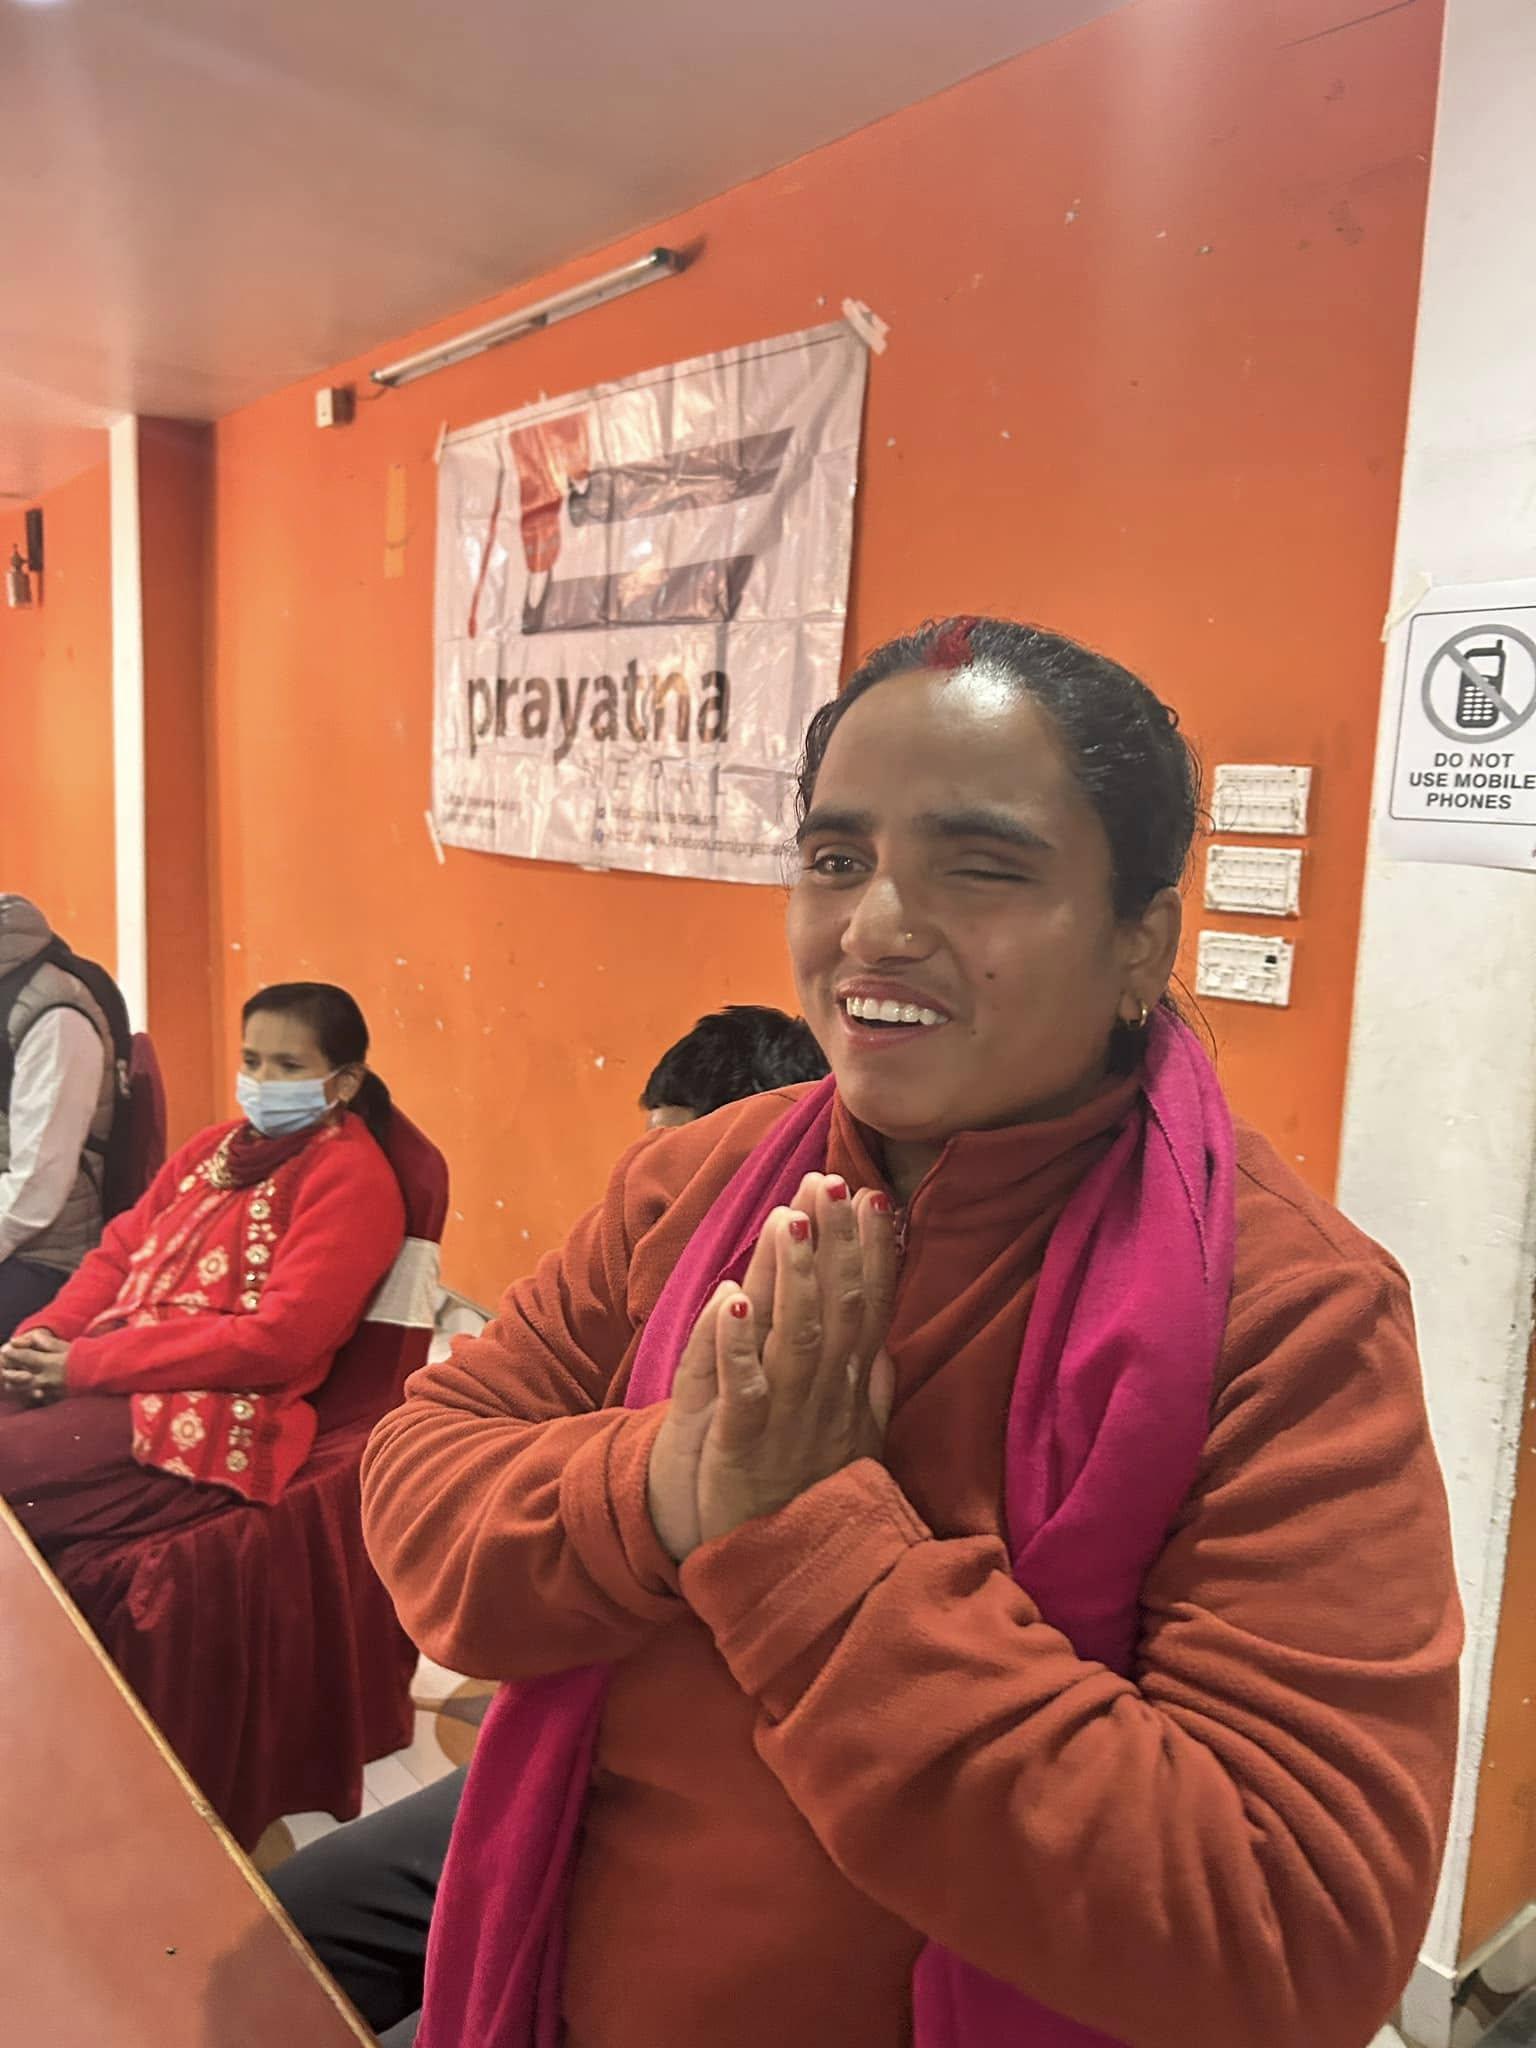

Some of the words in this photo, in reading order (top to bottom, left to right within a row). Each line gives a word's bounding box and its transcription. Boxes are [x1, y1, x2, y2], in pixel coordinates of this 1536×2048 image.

[468, 658, 731, 764] prayatna
[1433, 752, 1463, 768] DO
[1469, 752, 1514, 769] NOT
[1409, 772, 1448, 787] USE
[1454, 773, 1536, 789] MOBILE
[1425, 792, 1512, 810] PHONES
